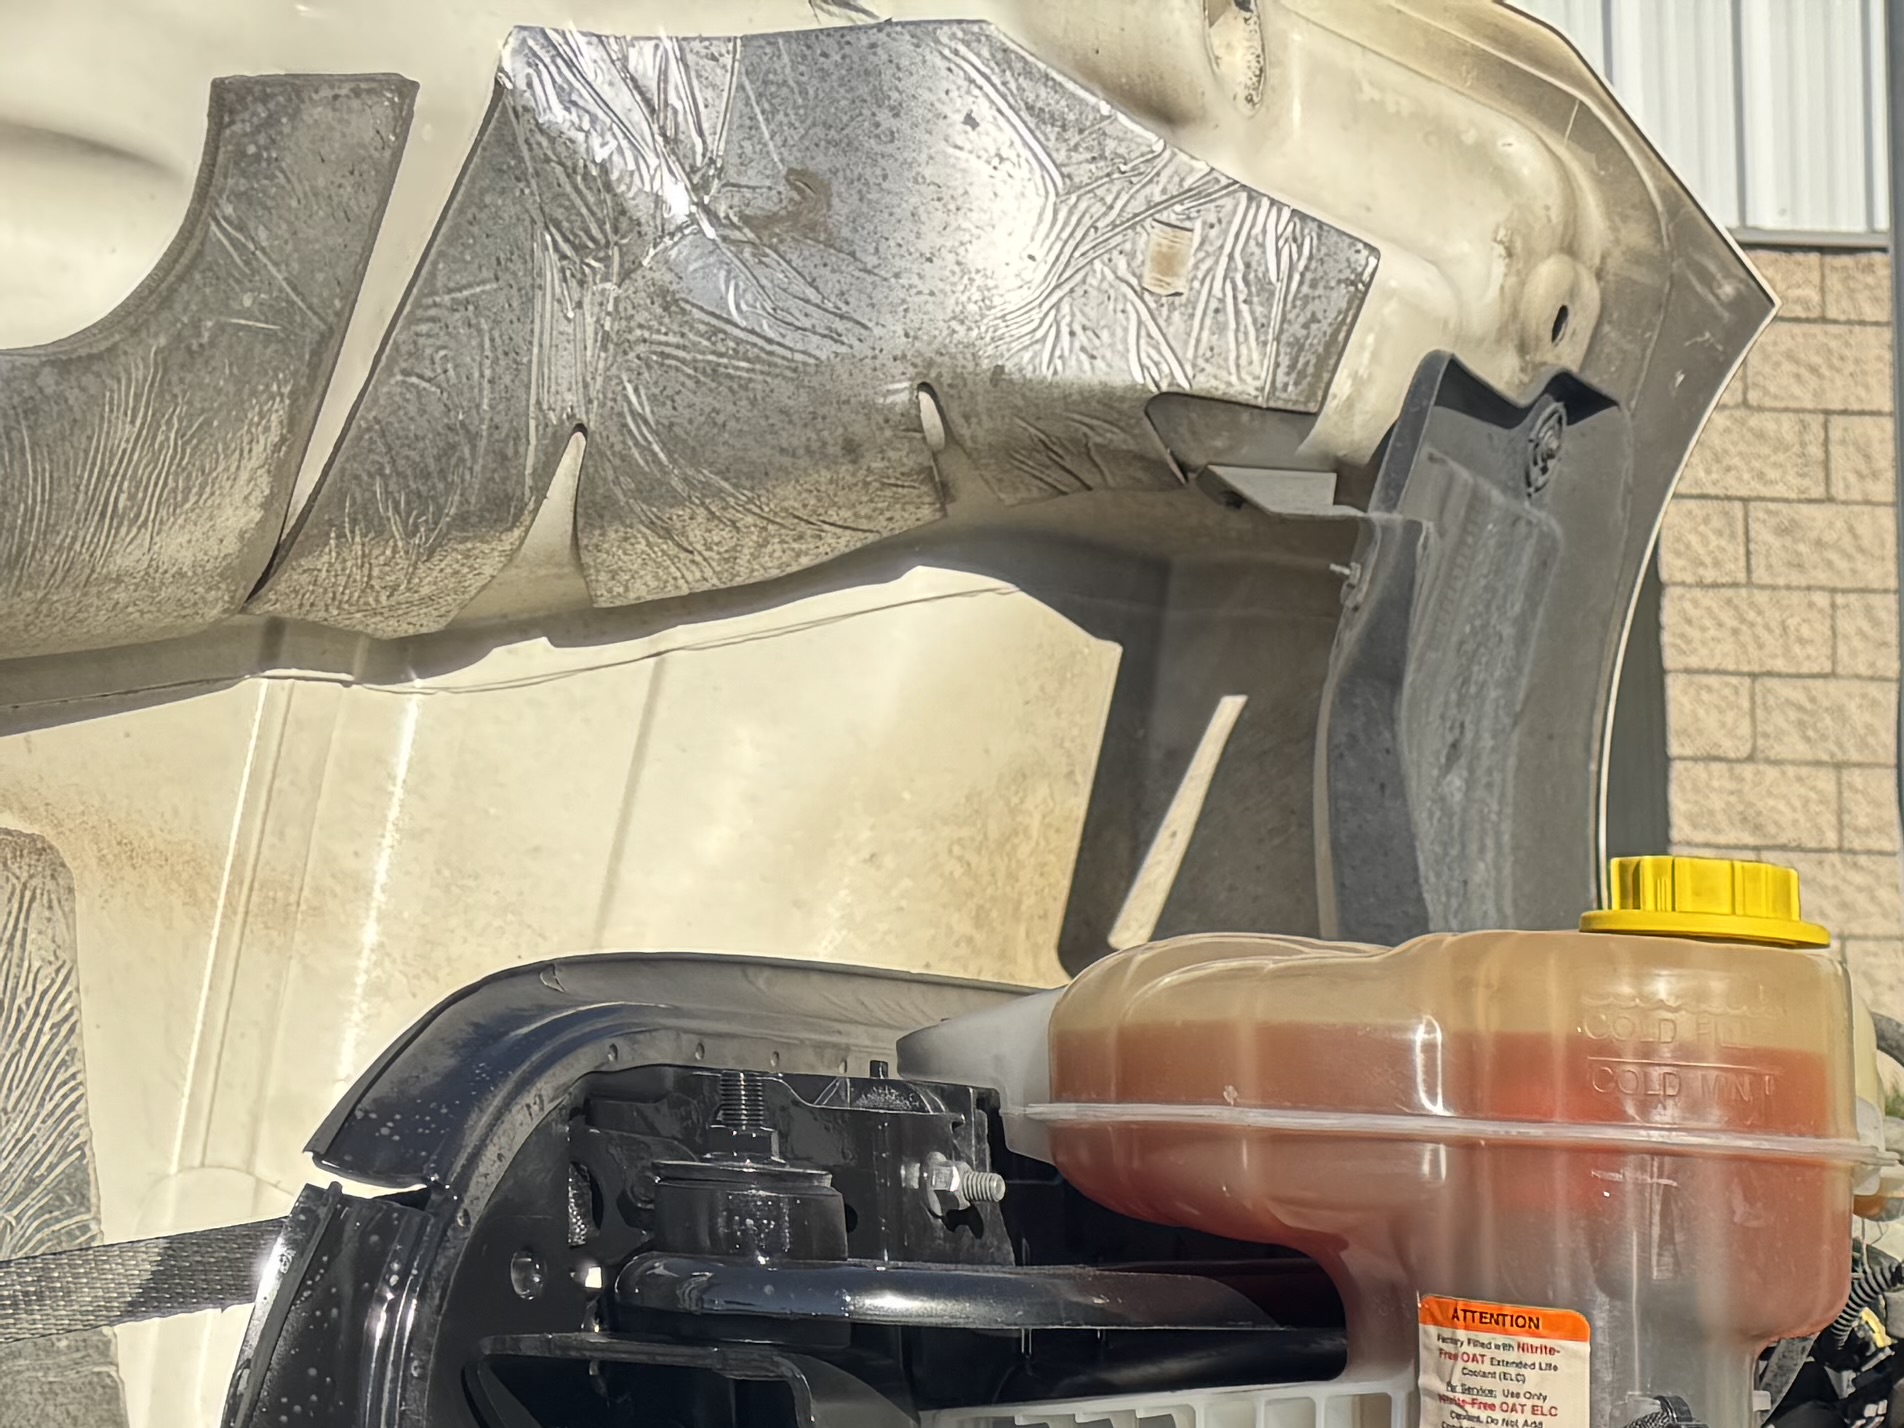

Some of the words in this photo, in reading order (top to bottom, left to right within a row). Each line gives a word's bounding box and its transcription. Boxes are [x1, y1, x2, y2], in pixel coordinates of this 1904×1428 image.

[1584, 1013, 1677, 1044] COLD
[1592, 1066, 1681, 1097] COLD
[1452, 1308, 1540, 1329] ATTENTION
[1517, 1342, 1561, 1356] Nitrite-
[1439, 1349, 1458, 1361] Free
[1461, 1353, 1486, 1365] OAT
[1490, 1357, 1535, 1370] Extended
[1539, 1362, 1558, 1372] Life
[1461, 1368, 1497, 1380] Coolant
[1499, 1372, 1526, 1384] (ELC)
[1502, 1389, 1521, 1399] Use
[1524, 1391, 1547, 1402] Only
[1500, 1402, 1527, 1414] OAT
[1531, 1405, 1558, 1417] ELC
[1486, 1416, 1498, 1425] Do
[1501, 1417, 1519, 1427] Not
